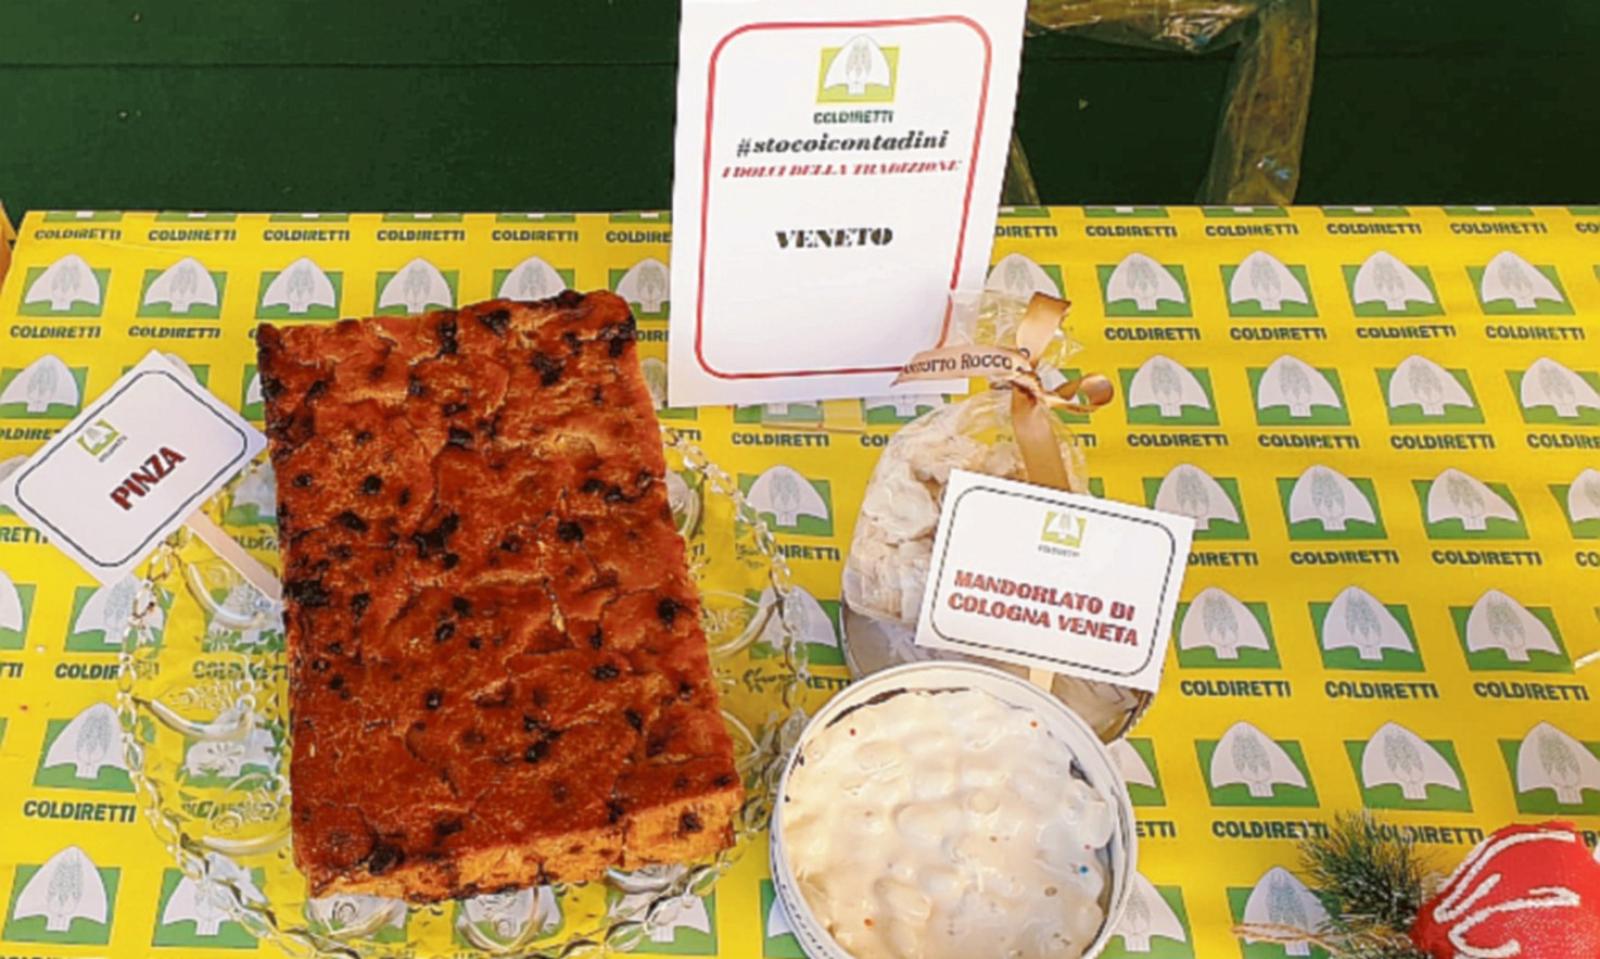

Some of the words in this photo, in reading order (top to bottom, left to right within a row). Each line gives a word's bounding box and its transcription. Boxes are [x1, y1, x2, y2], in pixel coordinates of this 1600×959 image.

[736, 130, 949, 157] #stocoicontadini
[35, 229, 121, 239] COLDIRETTI
[148, 230, 236, 241] COLDIRETTI
[263, 230, 350, 241] COLDIRETTI
[377, 230, 465, 241] COLDIRETTI
[994, 225, 1058, 238] DIRETTI
[1085, 225, 1177, 237] COLDIRETTI
[1205, 223, 1298, 237] COLDIRETTI
[1326, 223, 1421, 234] COLDIRETTI
[1450, 223, 1547, 234] COLDIRETTI
[492, 230, 579, 242] COLDIRETTI
[605, 230, 671, 244] COLDIRE
[775, 227, 893, 249] VENETO
[10, 325, 101, 339] COLDIRETTI
[128, 326, 221, 339] COLDIRETTI
[1104, 327, 1201, 341] COLDIRETTI
[1230, 327, 1327, 341] COLDIRETTI
[1356, 325, 1456, 339] COLDIRETTI
[1486, 326, 1583, 339] COLDIRETTI
[732, 433, 830, 447] COLDIRETTI
[1126, 433, 1229, 447] COLDIRETTI
[1257, 434, 1360, 449] COLDIRETTI
[1390, 434, 1495, 450] COLDIRETTI
[1527, 434, 1600, 448] COLDIRE
[108, 444, 191, 513] PINZA
[1187, 551, 1259, 567] DIRETTI
[1289, 549, 1400, 565] COLDIRETTI
[1431, 550, 1542, 565] COLDIRETTI
[954, 570, 1103, 615] MANDORLATO
[1109, 601, 1136, 621] DI
[948, 592, 1051, 628] COLOGNA
[1057, 615, 1139, 646] VENETA
[1180, 680, 1291, 697] COLDIRETTI
[1324, 680, 1440, 700] COLDIRETTI
[1473, 681, 1590, 701] COLDIRETTI
[23, 800, 137, 823] COLDIRETTI
